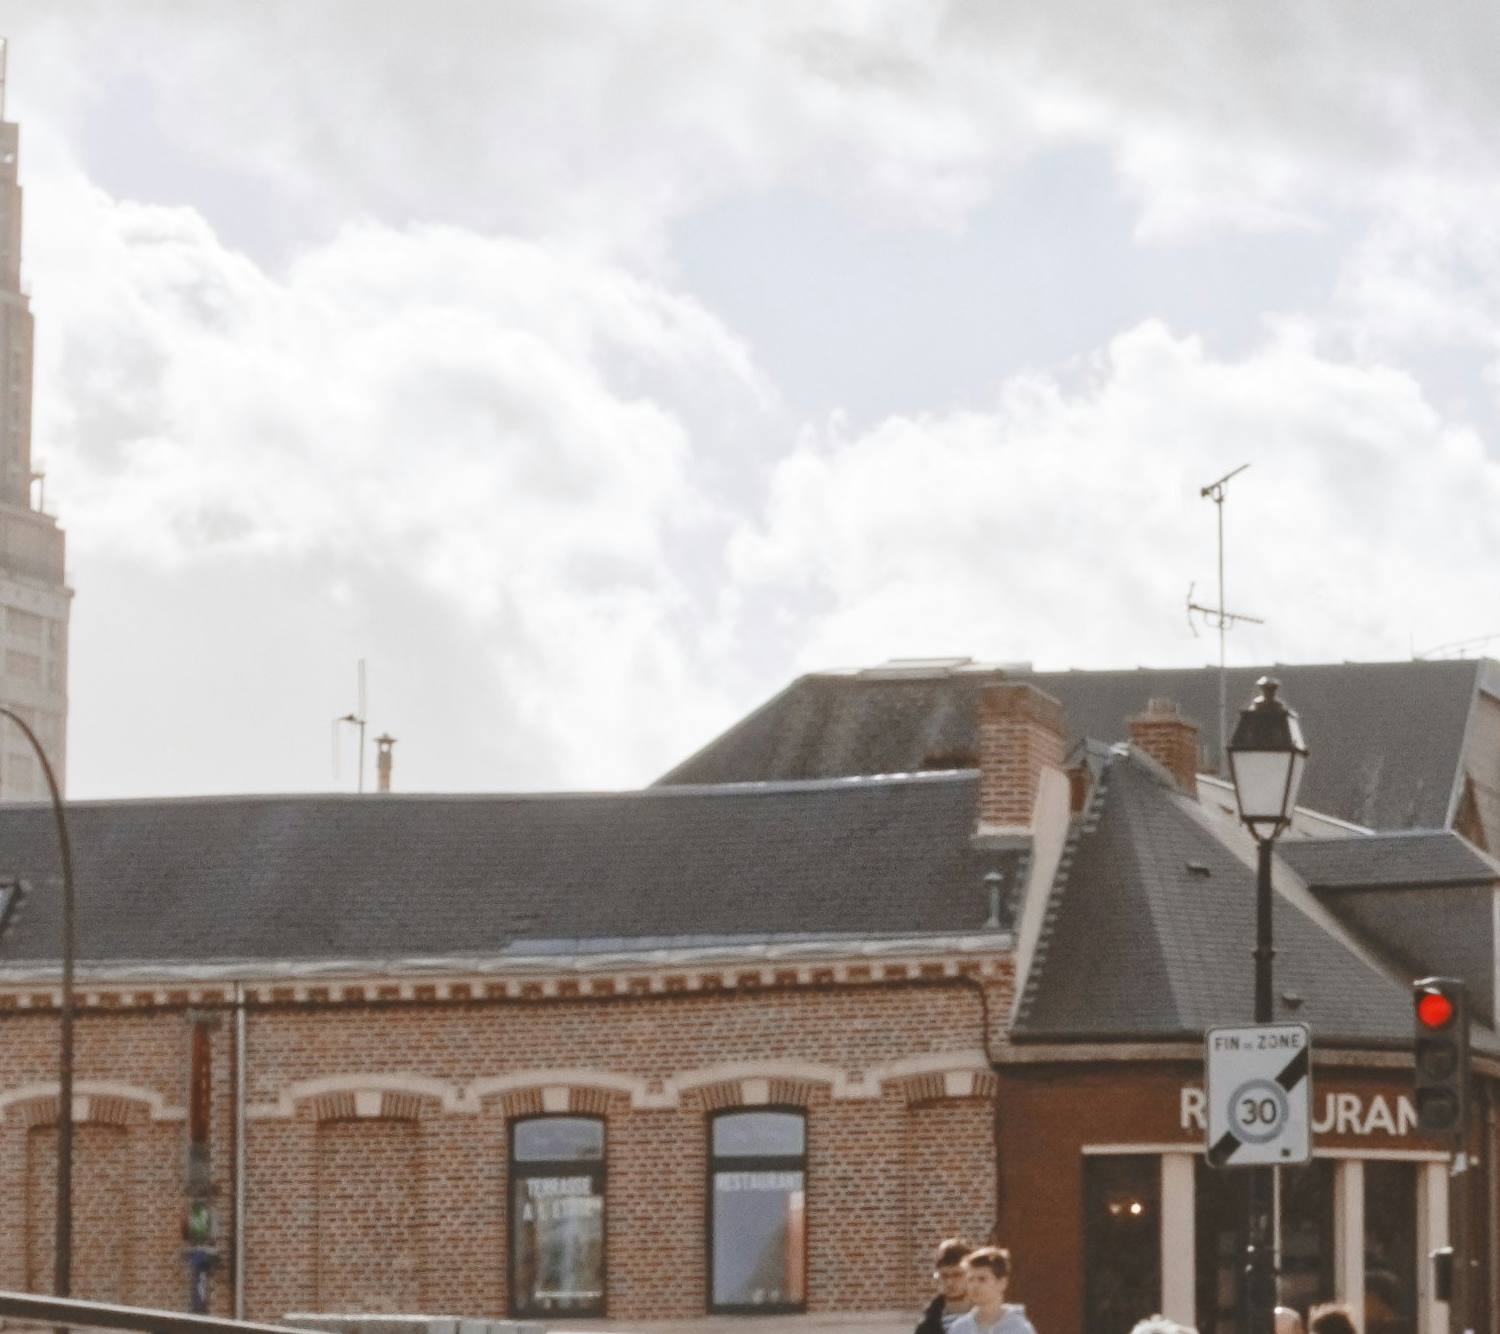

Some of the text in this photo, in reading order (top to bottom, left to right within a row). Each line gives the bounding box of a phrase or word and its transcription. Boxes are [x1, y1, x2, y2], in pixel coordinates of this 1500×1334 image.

[1214, 1036, 1241, 1051] FIN
[1257, 1034, 1301, 1049] ZONE
[1241, 1098, 1278, 1125] 30
